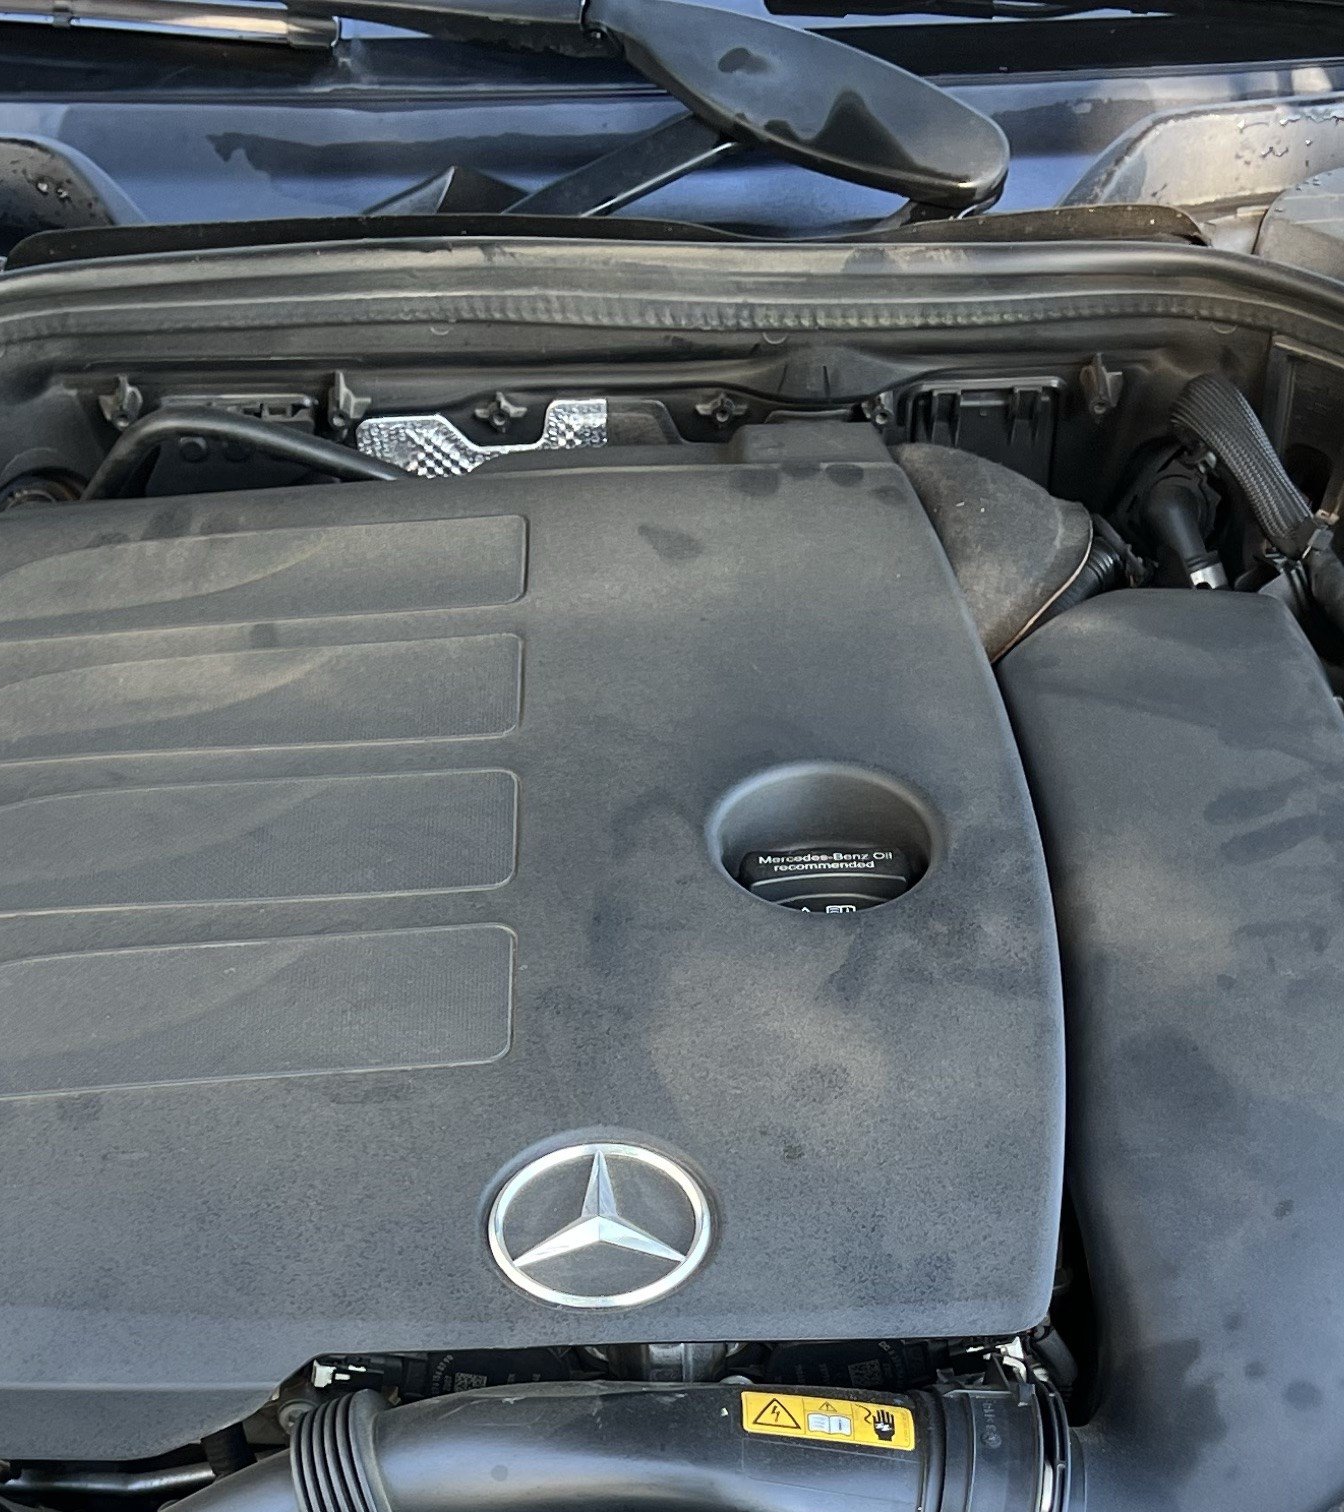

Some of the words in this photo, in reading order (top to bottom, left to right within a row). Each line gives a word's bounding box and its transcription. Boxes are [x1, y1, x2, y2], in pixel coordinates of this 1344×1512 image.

[758, 852, 869, 865] Mercedes-Benz
[872, 851, 893, 860] Oil
[773, 860, 875, 872] recommended
